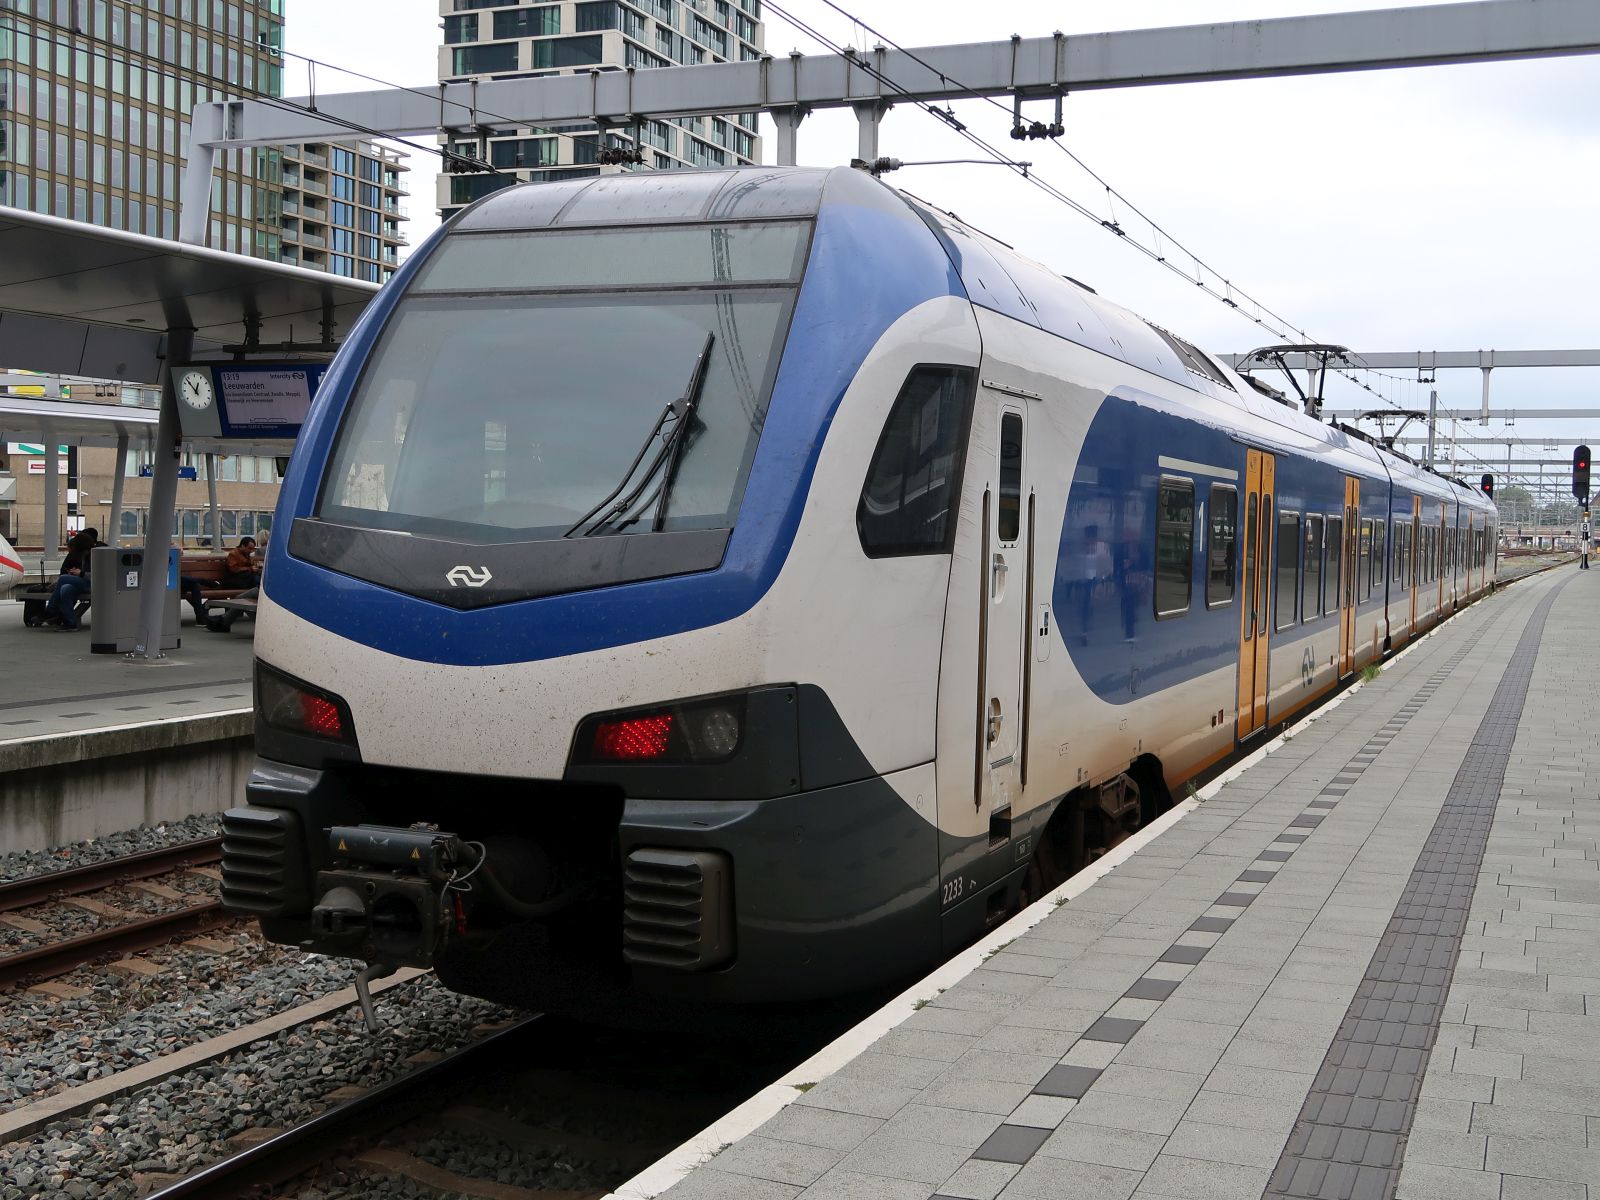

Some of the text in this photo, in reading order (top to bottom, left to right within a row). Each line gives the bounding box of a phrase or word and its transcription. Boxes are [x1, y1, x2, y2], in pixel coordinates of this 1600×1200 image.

[223, 373, 240, 381] 13:19
[224, 381, 265, 390] Leeuwarden
[1198, 501, 1204, 552] 1
[1583, 523, 1588, 531] 8
[942, 876, 963, 905] 2233
